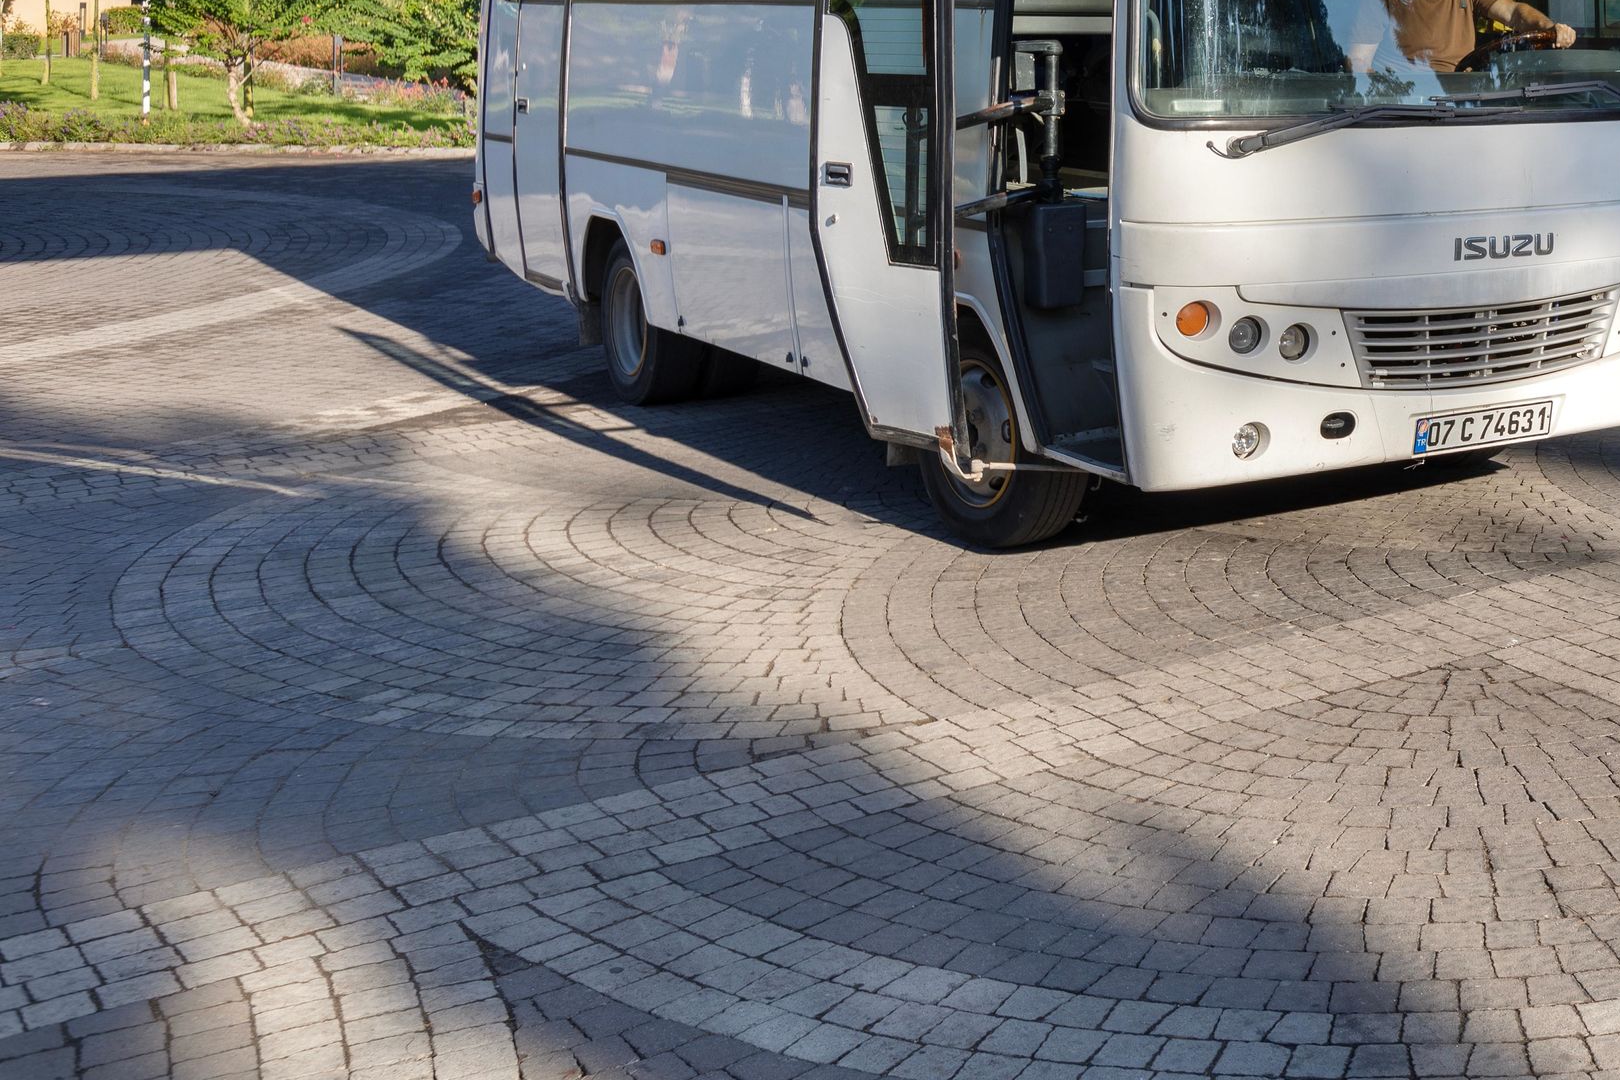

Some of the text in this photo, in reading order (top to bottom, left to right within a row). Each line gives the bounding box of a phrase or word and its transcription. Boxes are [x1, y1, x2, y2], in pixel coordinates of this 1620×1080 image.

[1454, 232, 1554, 261] ISUZU
[1427, 407, 1546, 446] 07 C 74631
[1416, 438, 1426, 447] TR
